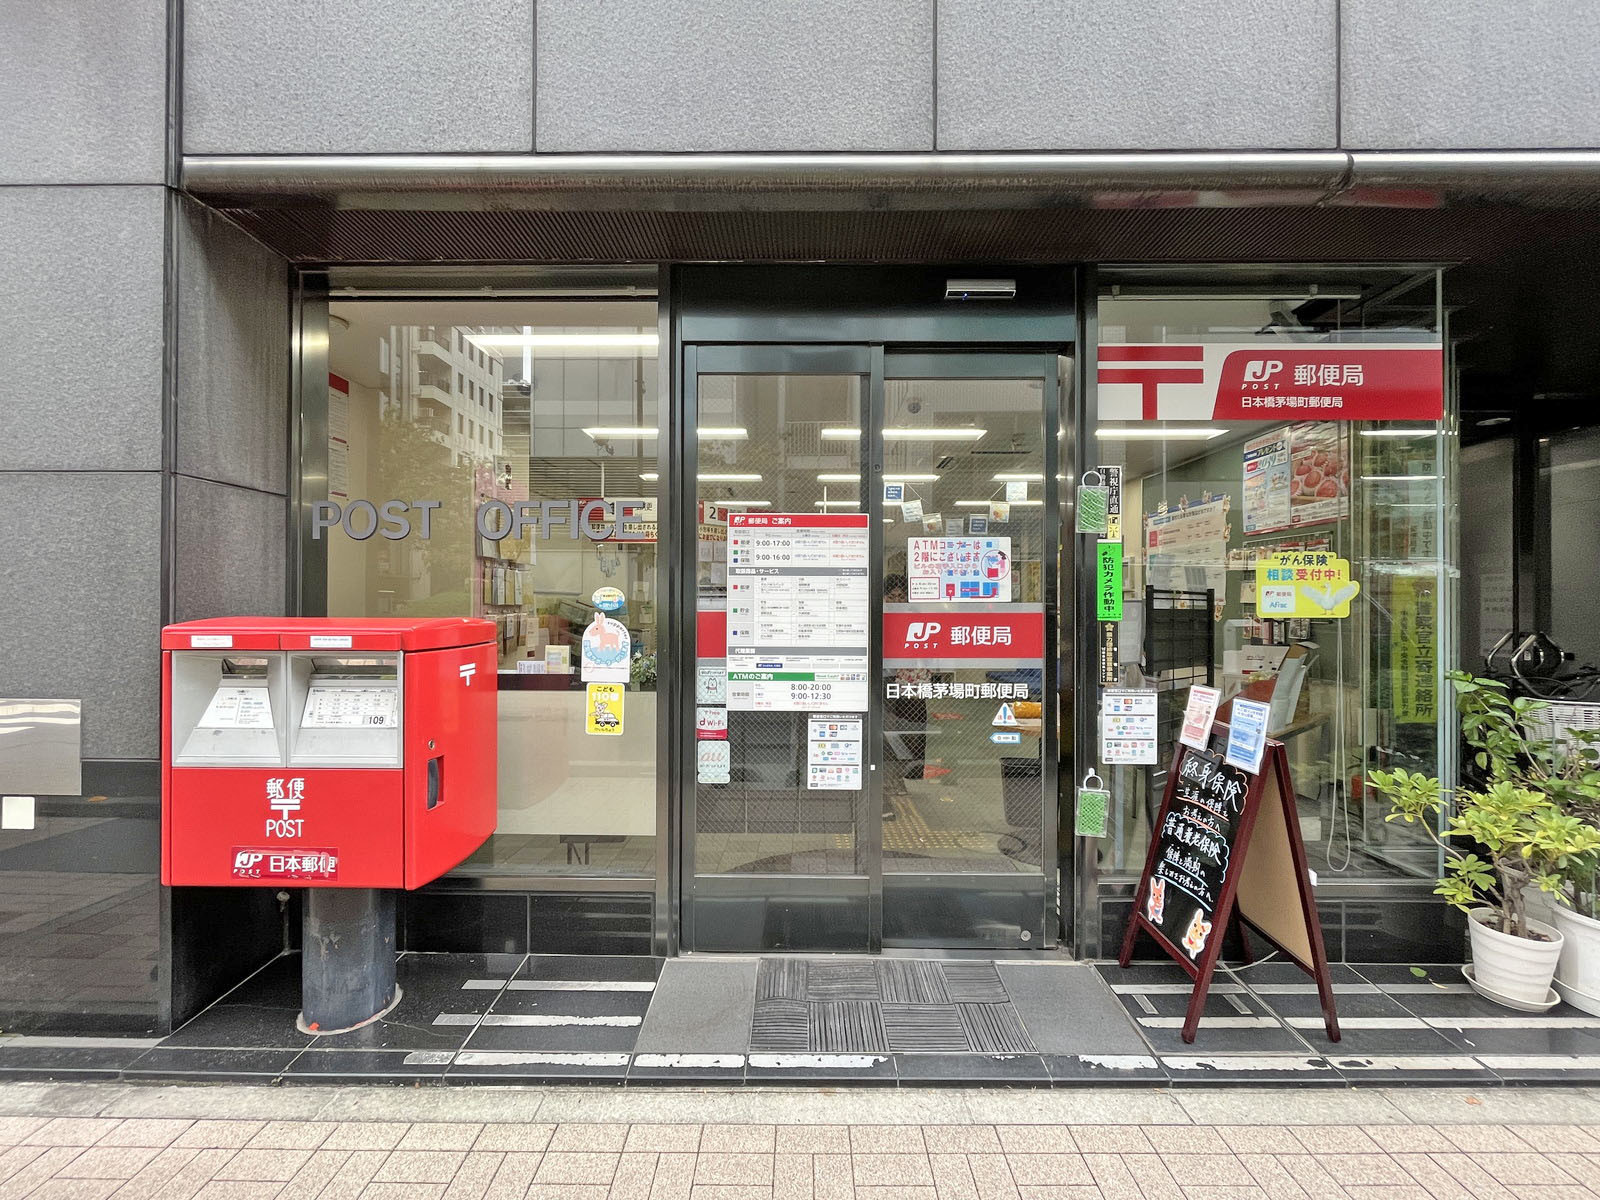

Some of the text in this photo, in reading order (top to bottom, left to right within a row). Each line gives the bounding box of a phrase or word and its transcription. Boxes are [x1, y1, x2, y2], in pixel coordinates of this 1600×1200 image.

[1293, 363, 1364, 387] 郵便局
[1241, 395, 1343, 409] 日本橋茅場町郵便局
[1109, 468, 1119, 514] 警視庁直通
[310, 499, 645, 541] POST OFFICE
[708, 506, 717, 520] 2
[748, 517, 792, 525] 郵便局 ご案内
[1102, 556, 1115, 612] 防犯カメラ作動中
[950, 625, 1012, 646] 郵便局
[732, 673, 774, 681] ATMのご案内
[790, 683, 832, 691] 8:00-20:00
[790, 692, 832, 700] 9:00-12:30
[886, 683, 1029, 700] 日本橋茅場町郵便局
[369, 715, 385, 726] 109
[700, 752, 726, 762] au
[265, 777, 305, 800] 郵便
[1181, 756, 1241, 813] 終身保険
[265, 819, 305, 838] POST
[1164, 816, 1222, 866] 普通養老保険
[269, 854, 337, 873] 日本郵便
